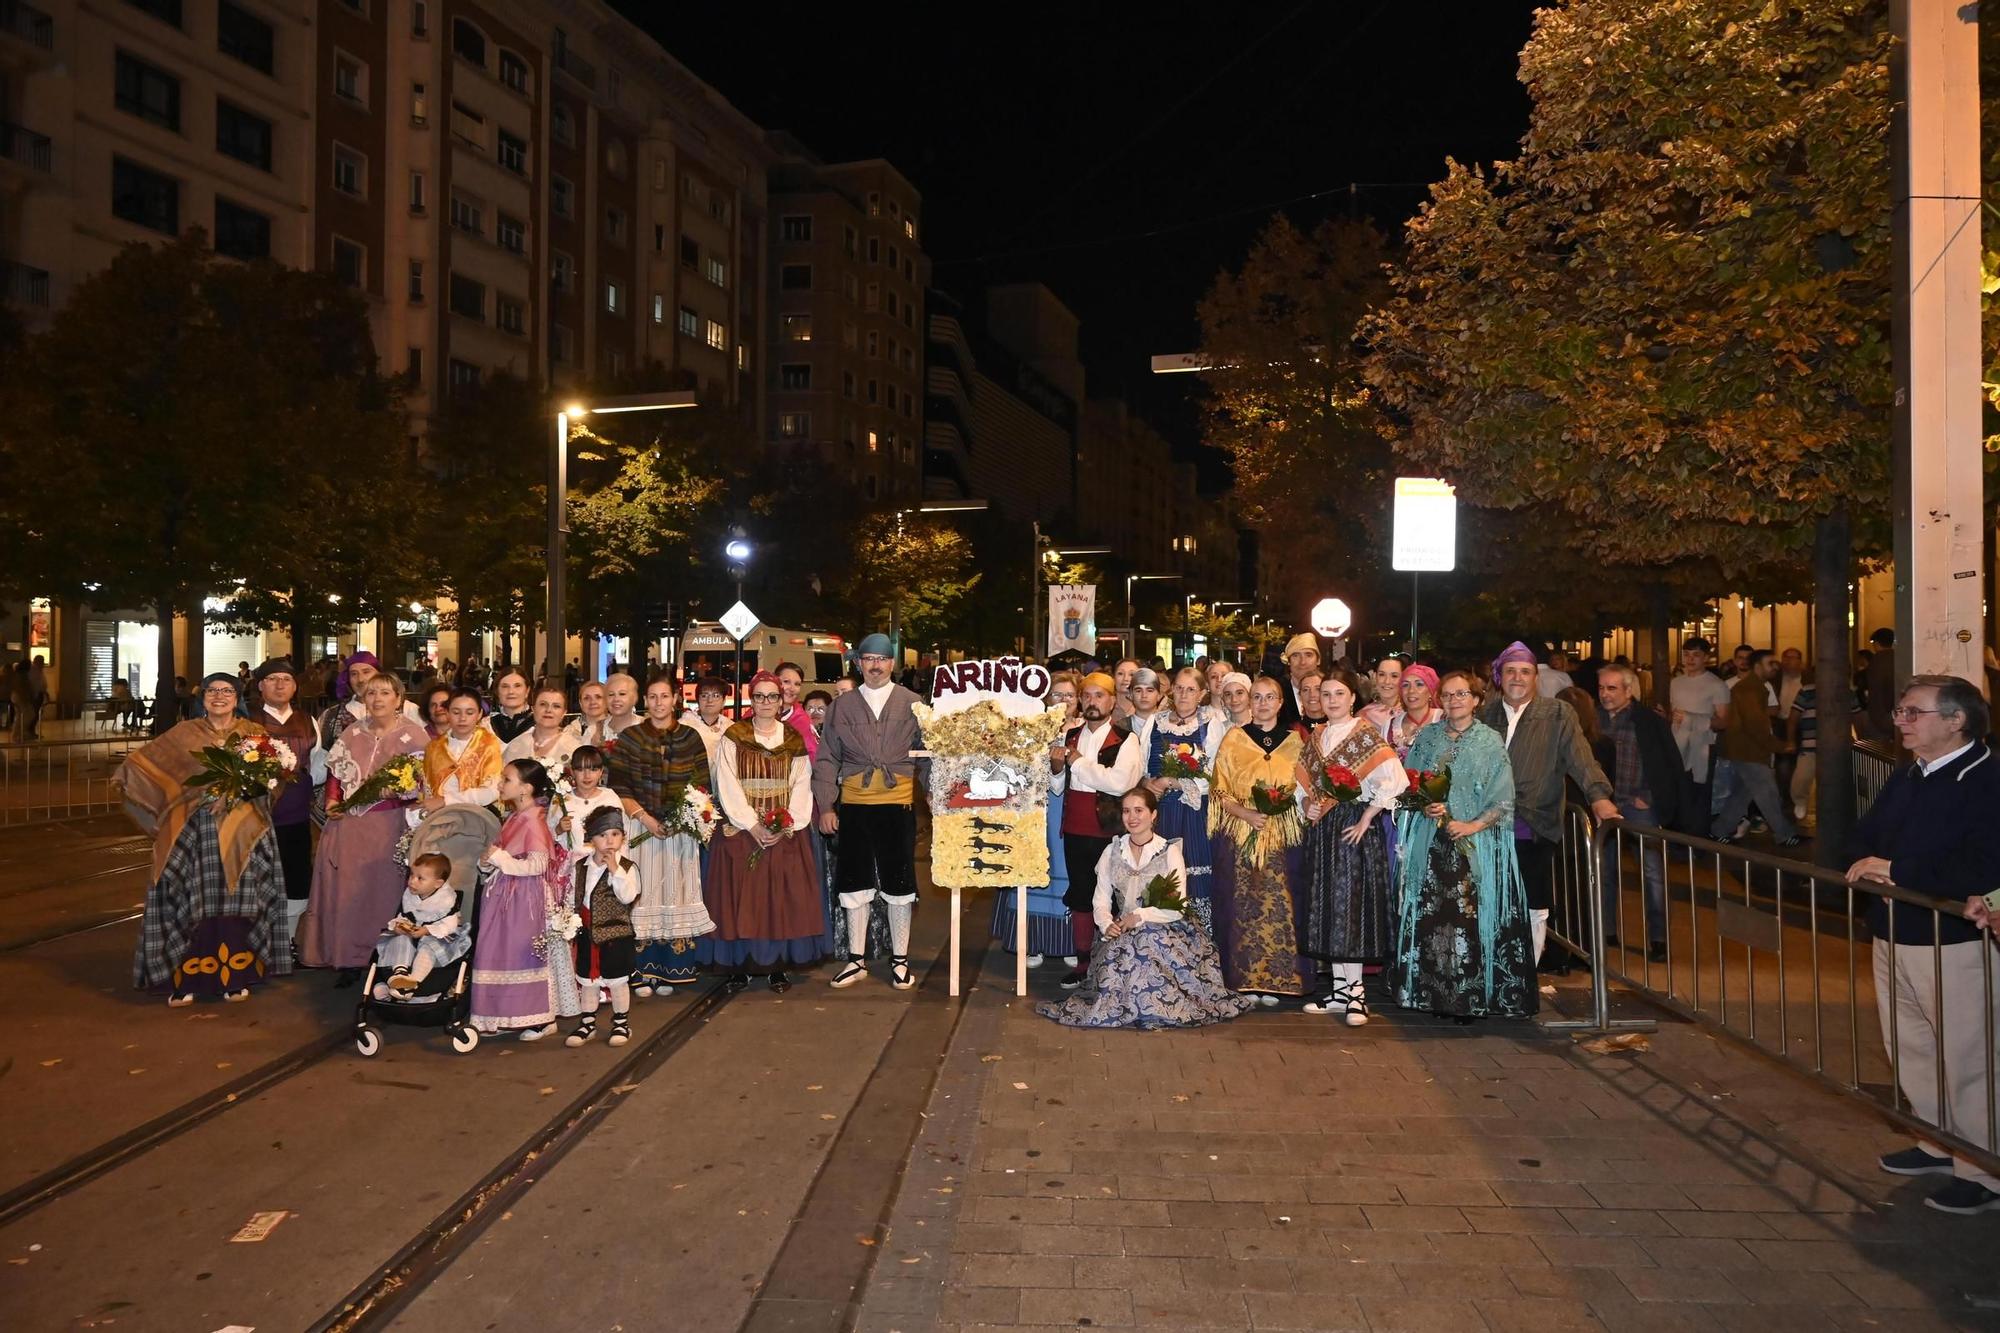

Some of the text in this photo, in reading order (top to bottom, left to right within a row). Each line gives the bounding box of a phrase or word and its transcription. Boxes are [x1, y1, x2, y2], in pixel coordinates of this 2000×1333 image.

[1055, 593, 1089, 603] LAYANA
[692, 637, 732, 645] AMBULA
[932, 658, 1049, 698] ARIÑO
